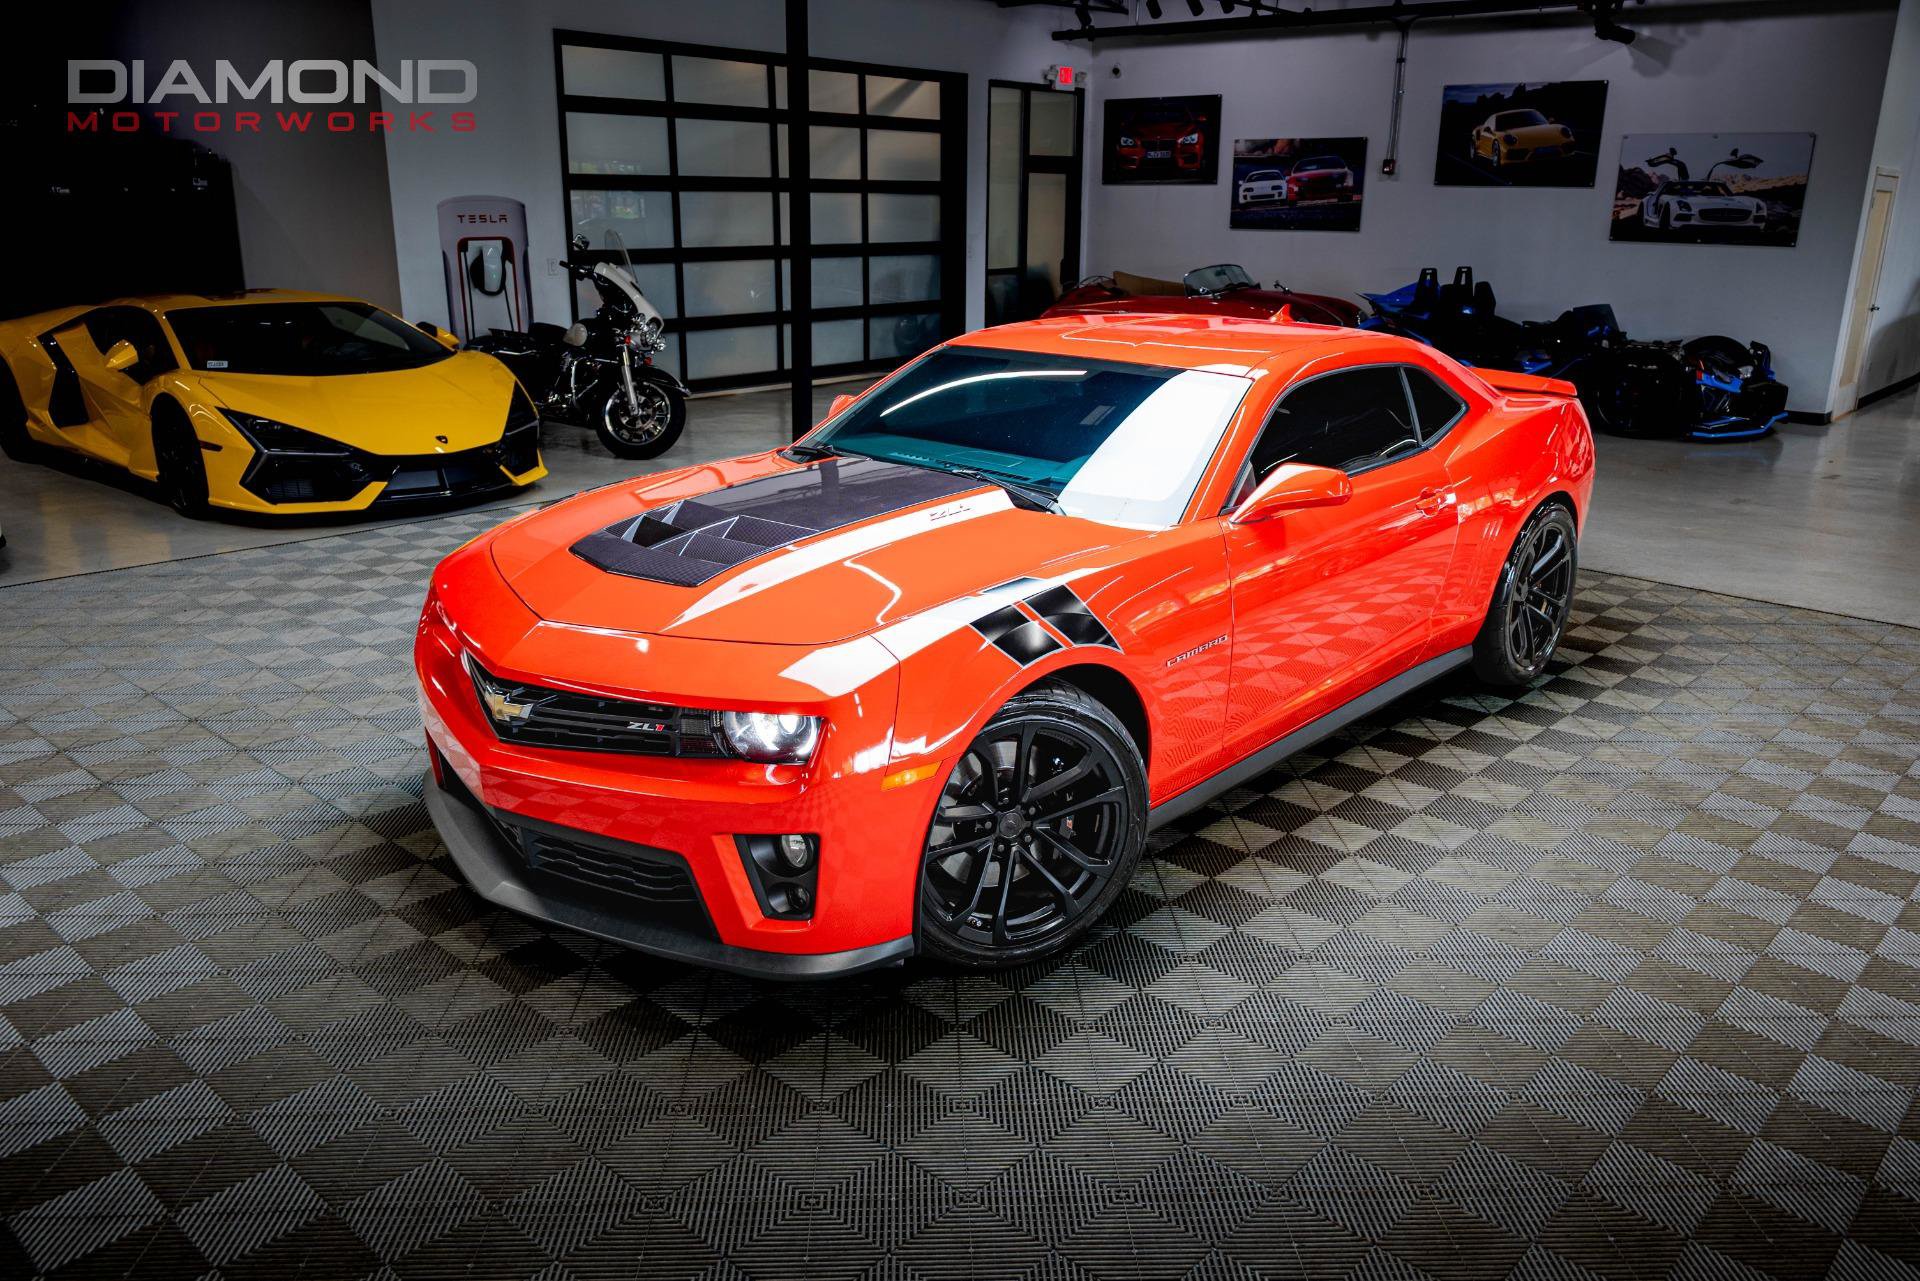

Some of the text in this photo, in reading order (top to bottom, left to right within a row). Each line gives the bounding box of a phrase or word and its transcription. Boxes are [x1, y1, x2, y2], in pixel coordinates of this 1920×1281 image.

[456, 214, 508, 224] TESLA
[1165, 633, 1228, 667] CAMARO
[626, 721, 666, 732] ZL1
